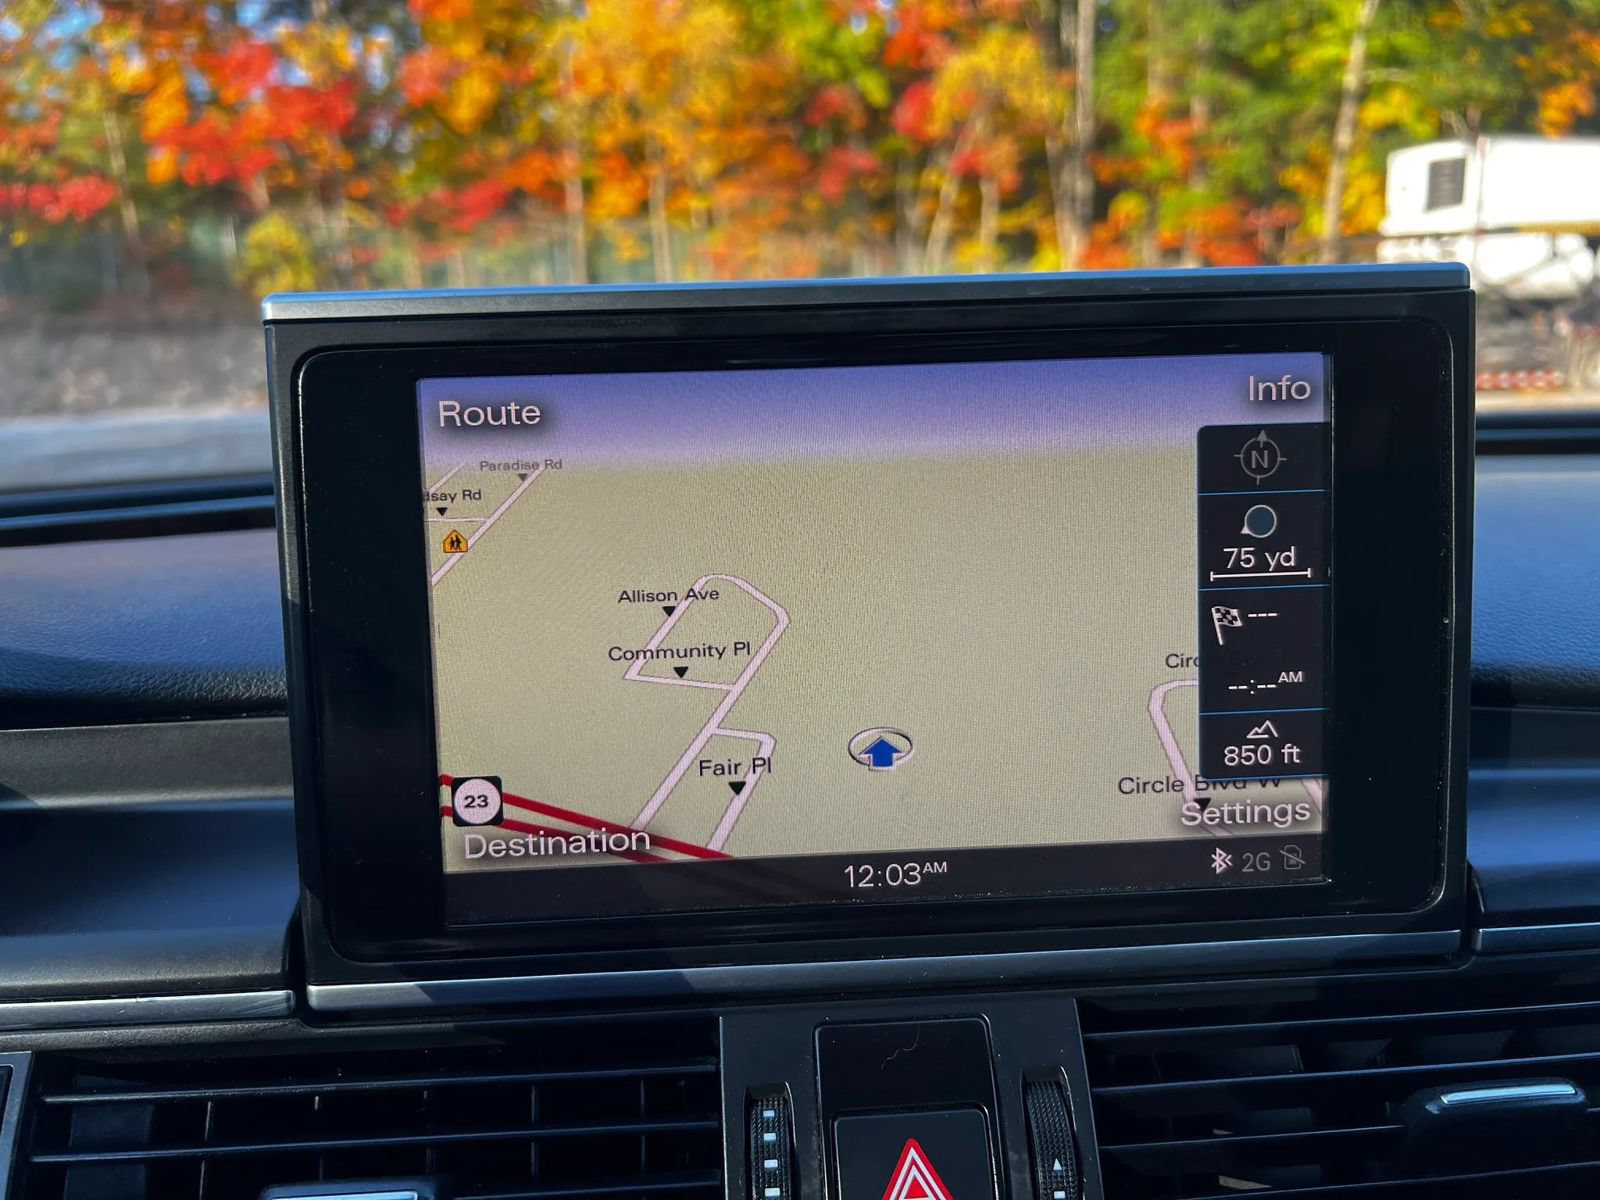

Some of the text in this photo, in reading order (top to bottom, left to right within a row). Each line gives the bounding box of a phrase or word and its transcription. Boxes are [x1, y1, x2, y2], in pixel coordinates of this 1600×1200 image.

[1248, 374, 1311, 402] Info
[437, 400, 541, 427] Route
[479, 458, 563, 472] Paradise Rd
[1251, 450, 1269, 468] N
[462, 489, 482, 501] Rd
[1223, 546, 1296, 572] 75 yd
[618, 588, 720, 603] Allison Ave
[607, 641, 751, 661] Community Pl
[1223, 743, 1301, 766] 850 ft
[698, 757, 772, 777] Fair Pl
[1118, 775, 1185, 795] Circle
[463, 794, 489, 809] 23
[1180, 800, 1312, 828] Settings
[463, 827, 651, 859] Destination
[1241, 852, 1271, 872] 2G
